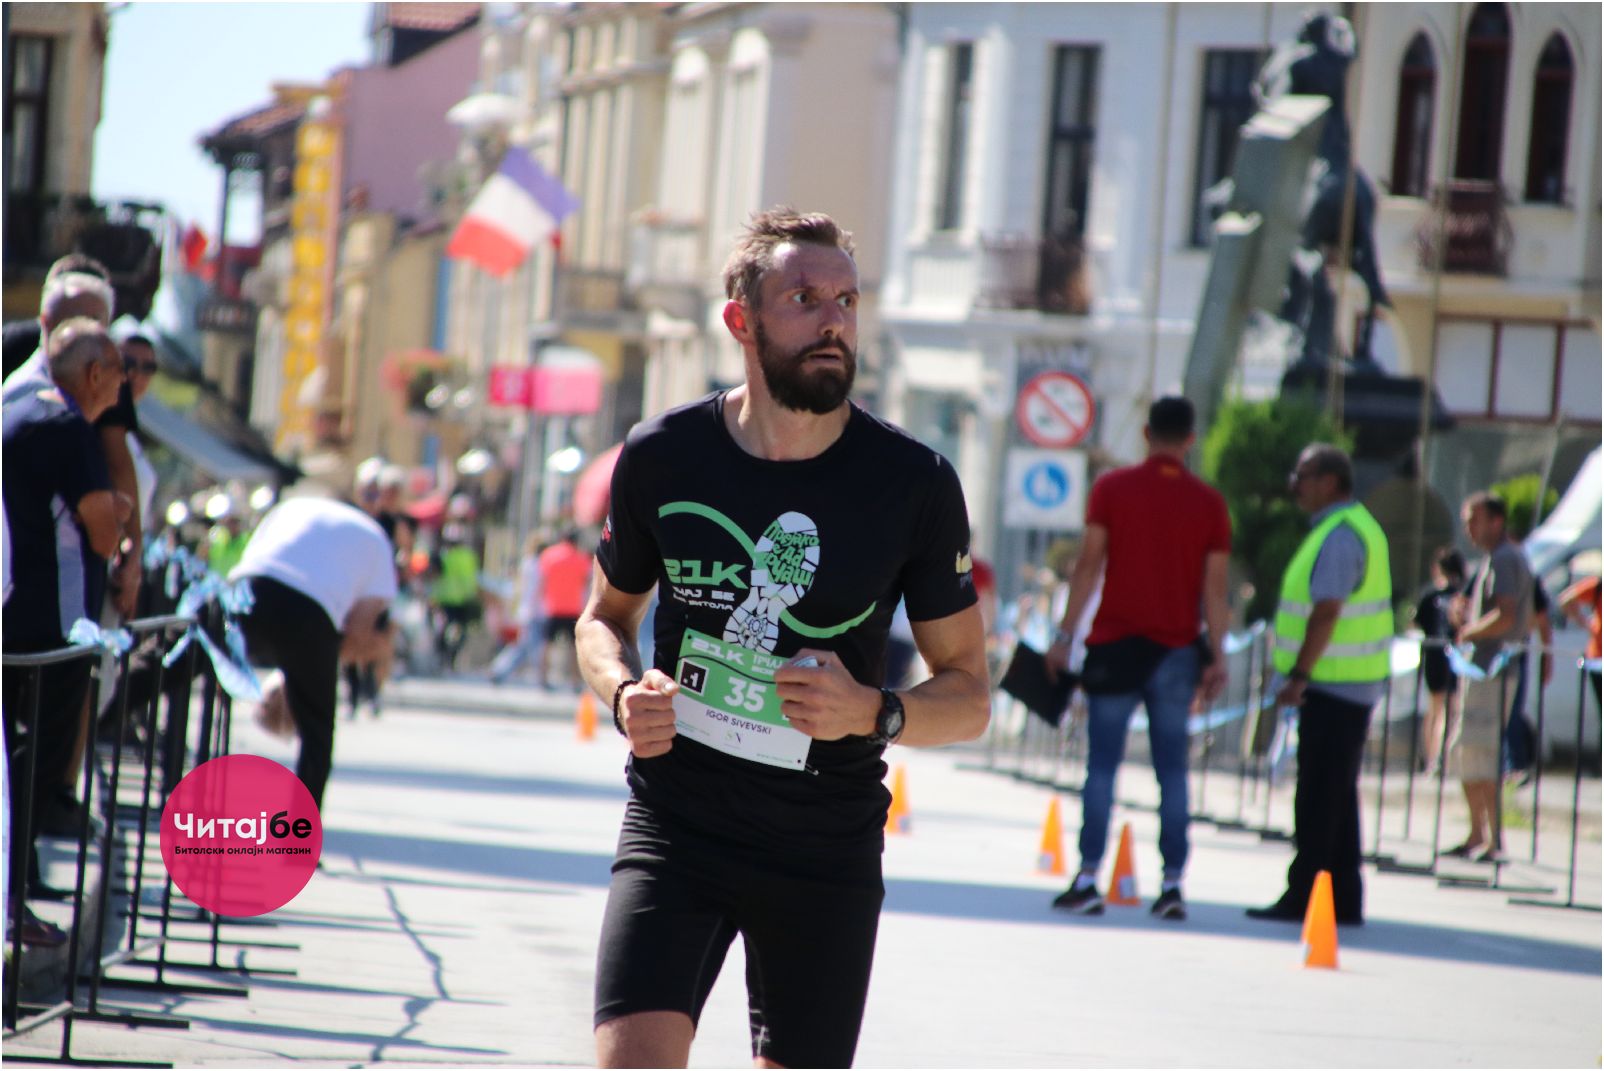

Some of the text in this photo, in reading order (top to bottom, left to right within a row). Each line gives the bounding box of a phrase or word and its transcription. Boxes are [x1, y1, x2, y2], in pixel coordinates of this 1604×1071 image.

[723, 676, 768, 713] 35
[706, 709, 729, 724] IGOR
[730, 717, 773, 736] SIVEVSKI
